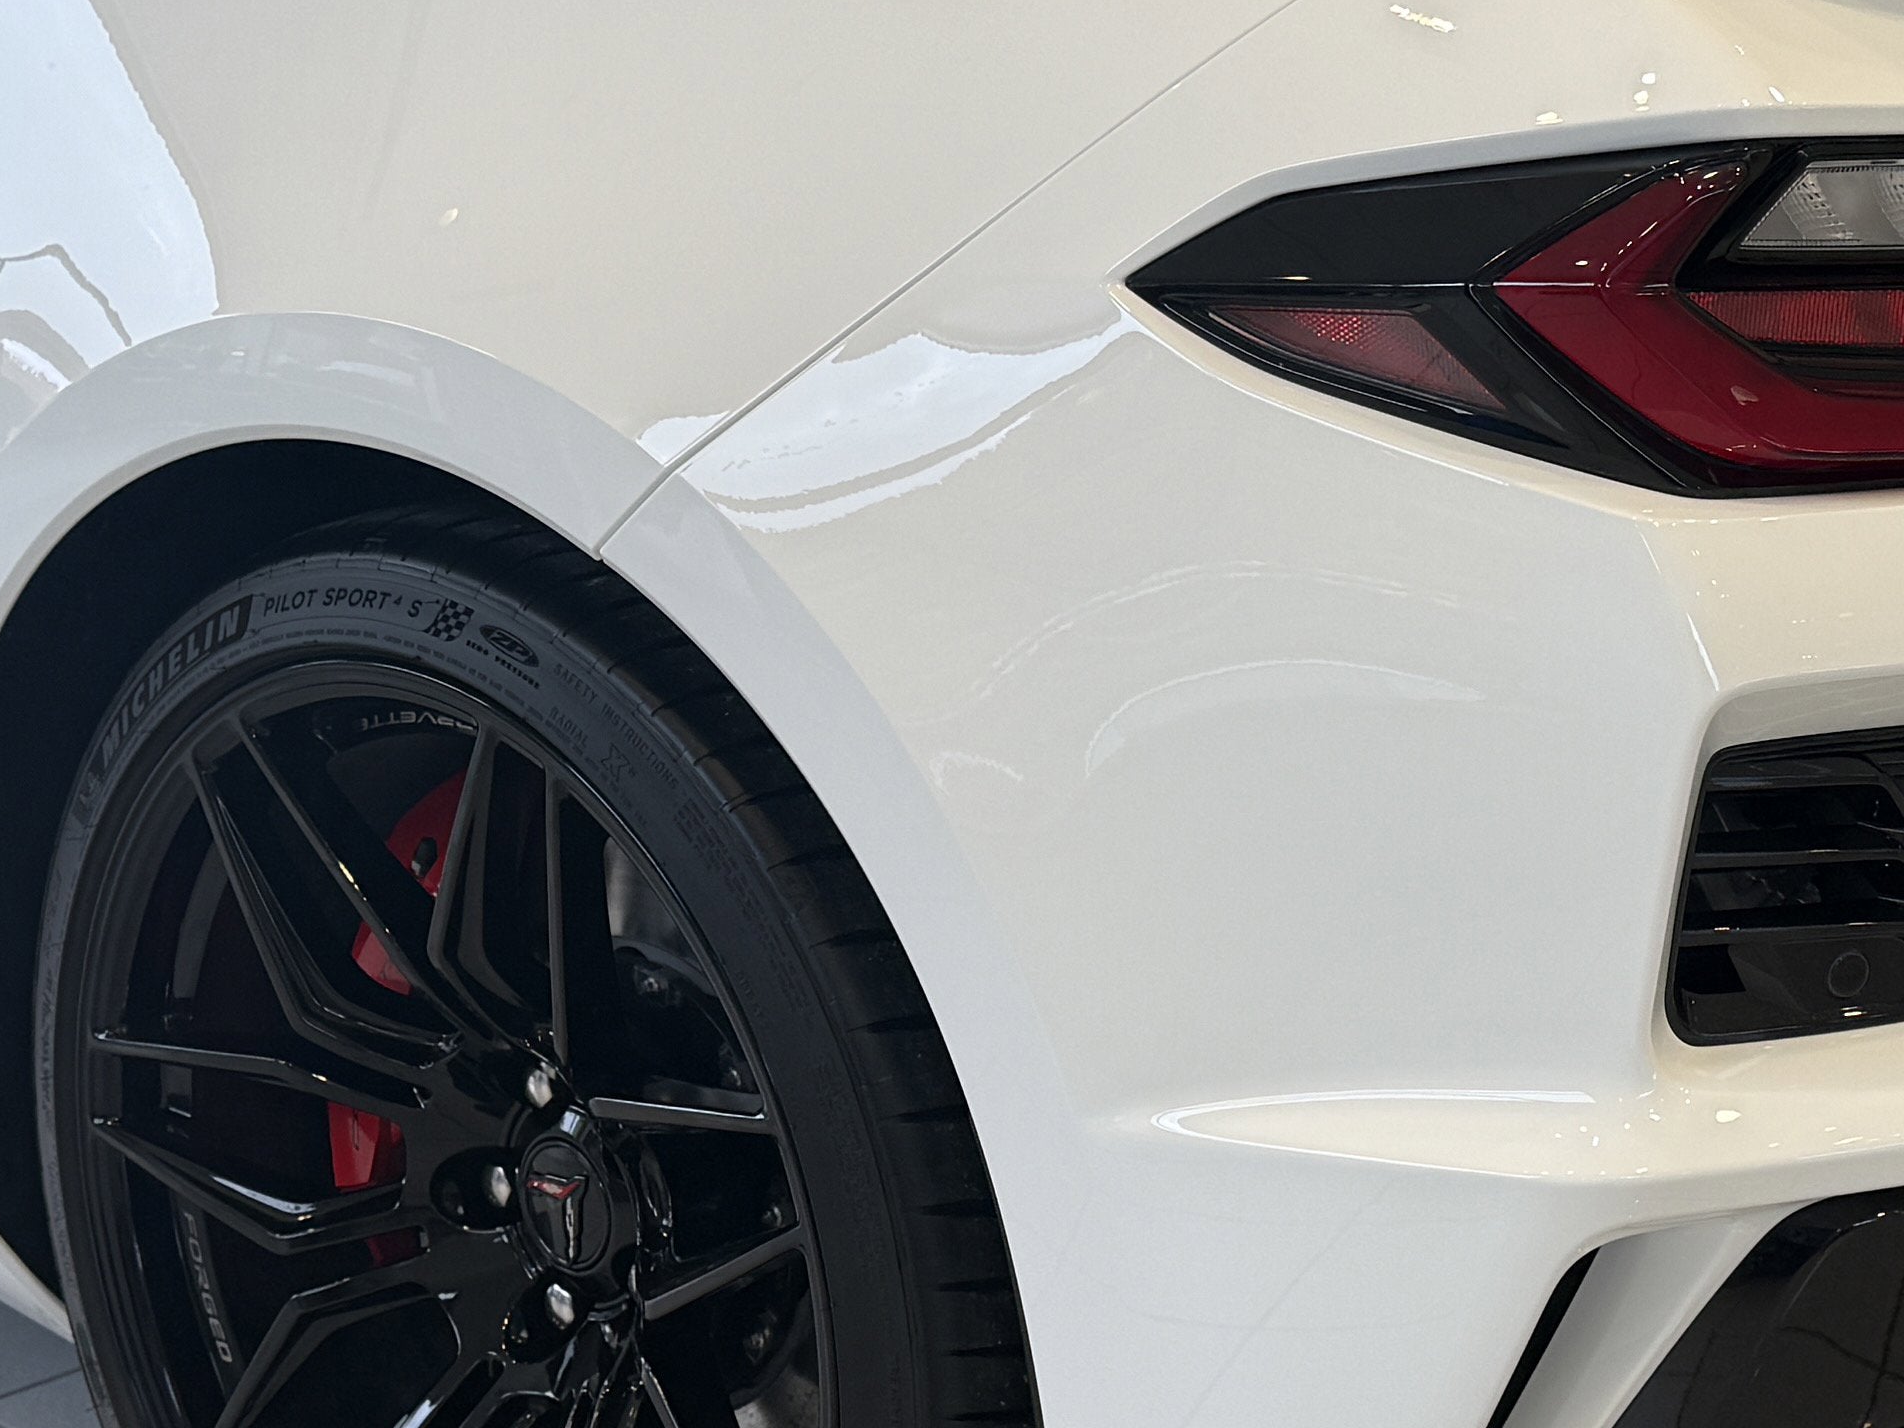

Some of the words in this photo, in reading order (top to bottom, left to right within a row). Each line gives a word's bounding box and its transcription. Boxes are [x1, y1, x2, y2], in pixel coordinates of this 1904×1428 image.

[101, 605, 240, 769] MICHELIN
[263, 588, 318, 618] PILOT
[322, 586, 392, 611] SPORT
[407, 599, 424, 619] S
[552, 662, 599, 707] SAFETY
[600, 702, 682, 791] INSTRUCTIONS
[182, 1211, 233, 1364] FORGED
